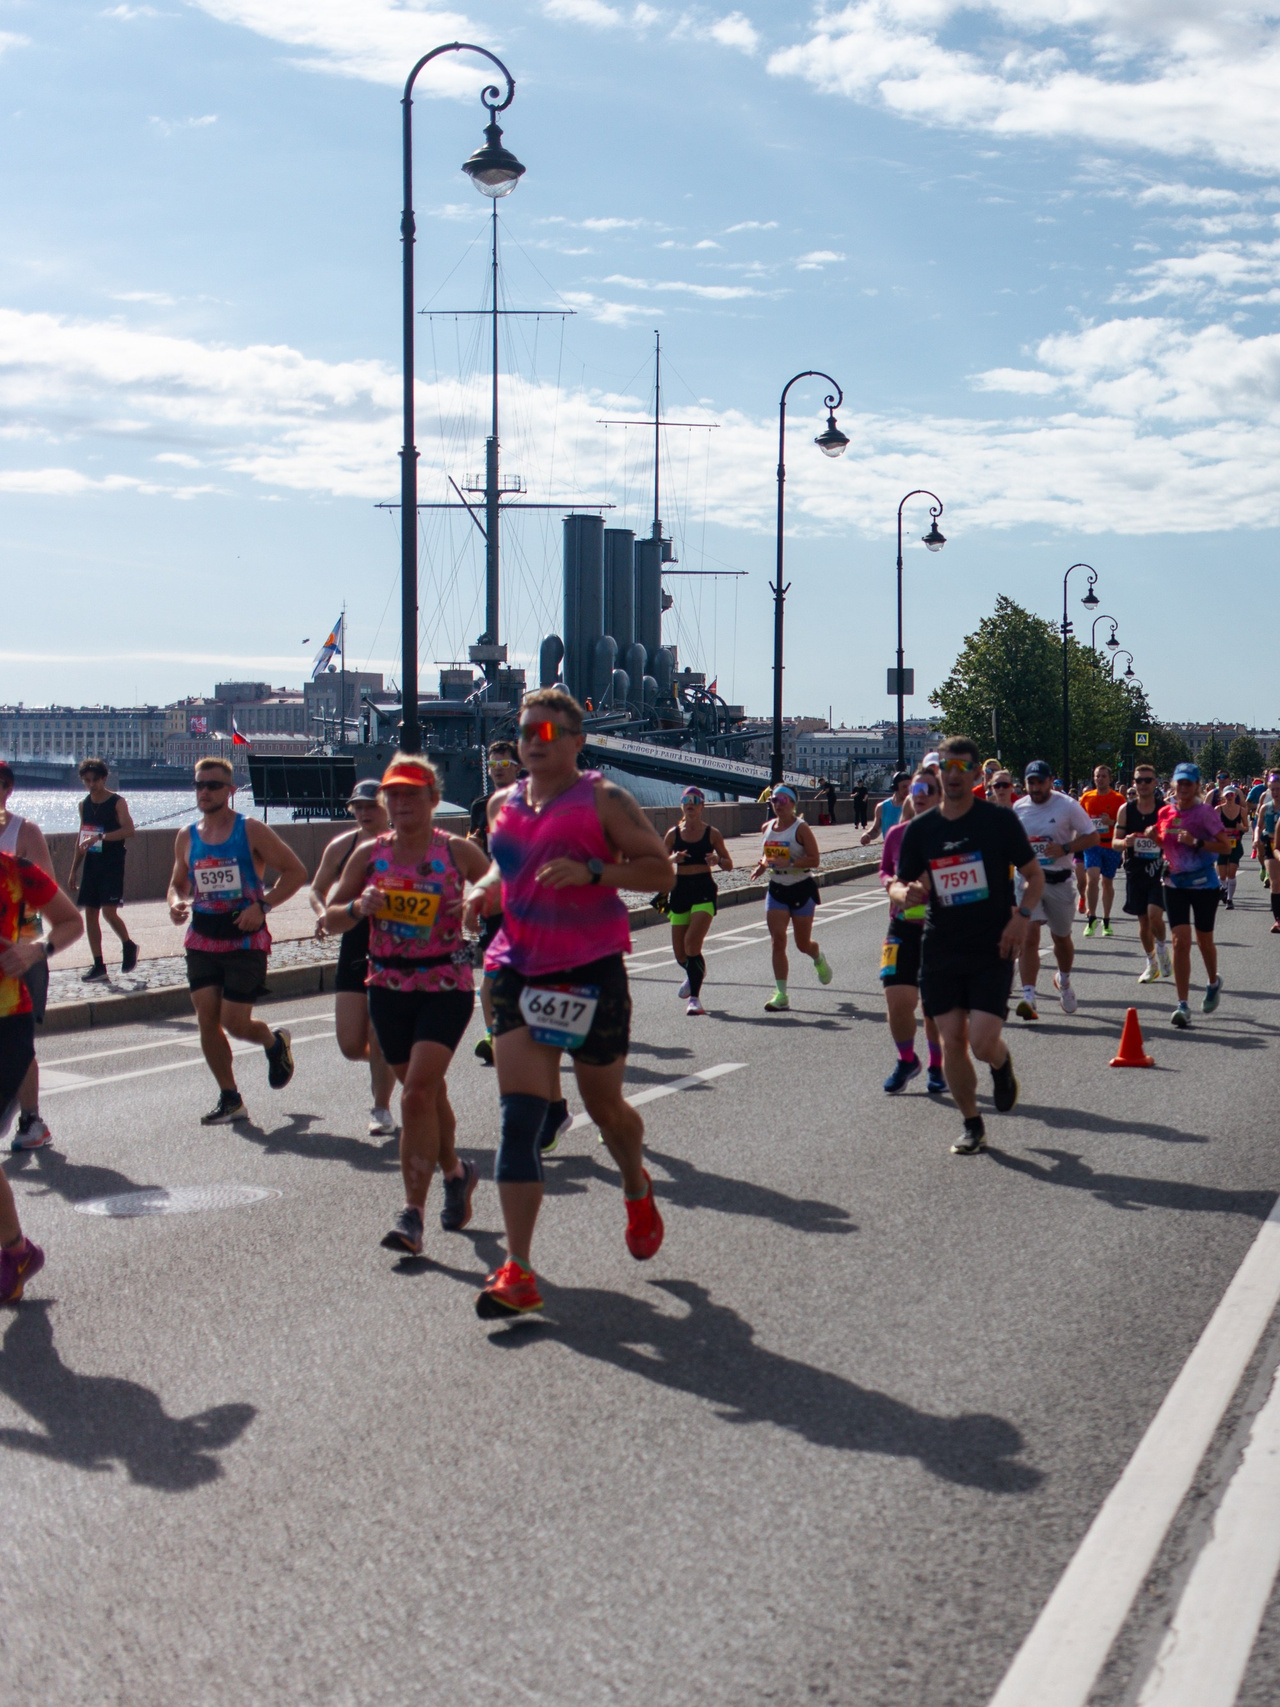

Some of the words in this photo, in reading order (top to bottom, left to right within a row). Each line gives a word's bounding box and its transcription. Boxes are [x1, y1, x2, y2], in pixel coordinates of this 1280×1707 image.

[734, 765, 758, 775] ФЛОТА
[1136, 839, 1158, 849] 6305
[200, 870, 234, 885] 5395
[940, 868, 978, 889] 7591
[383, 894, 431, 917] 1392
[528, 994, 587, 1022] 6617
